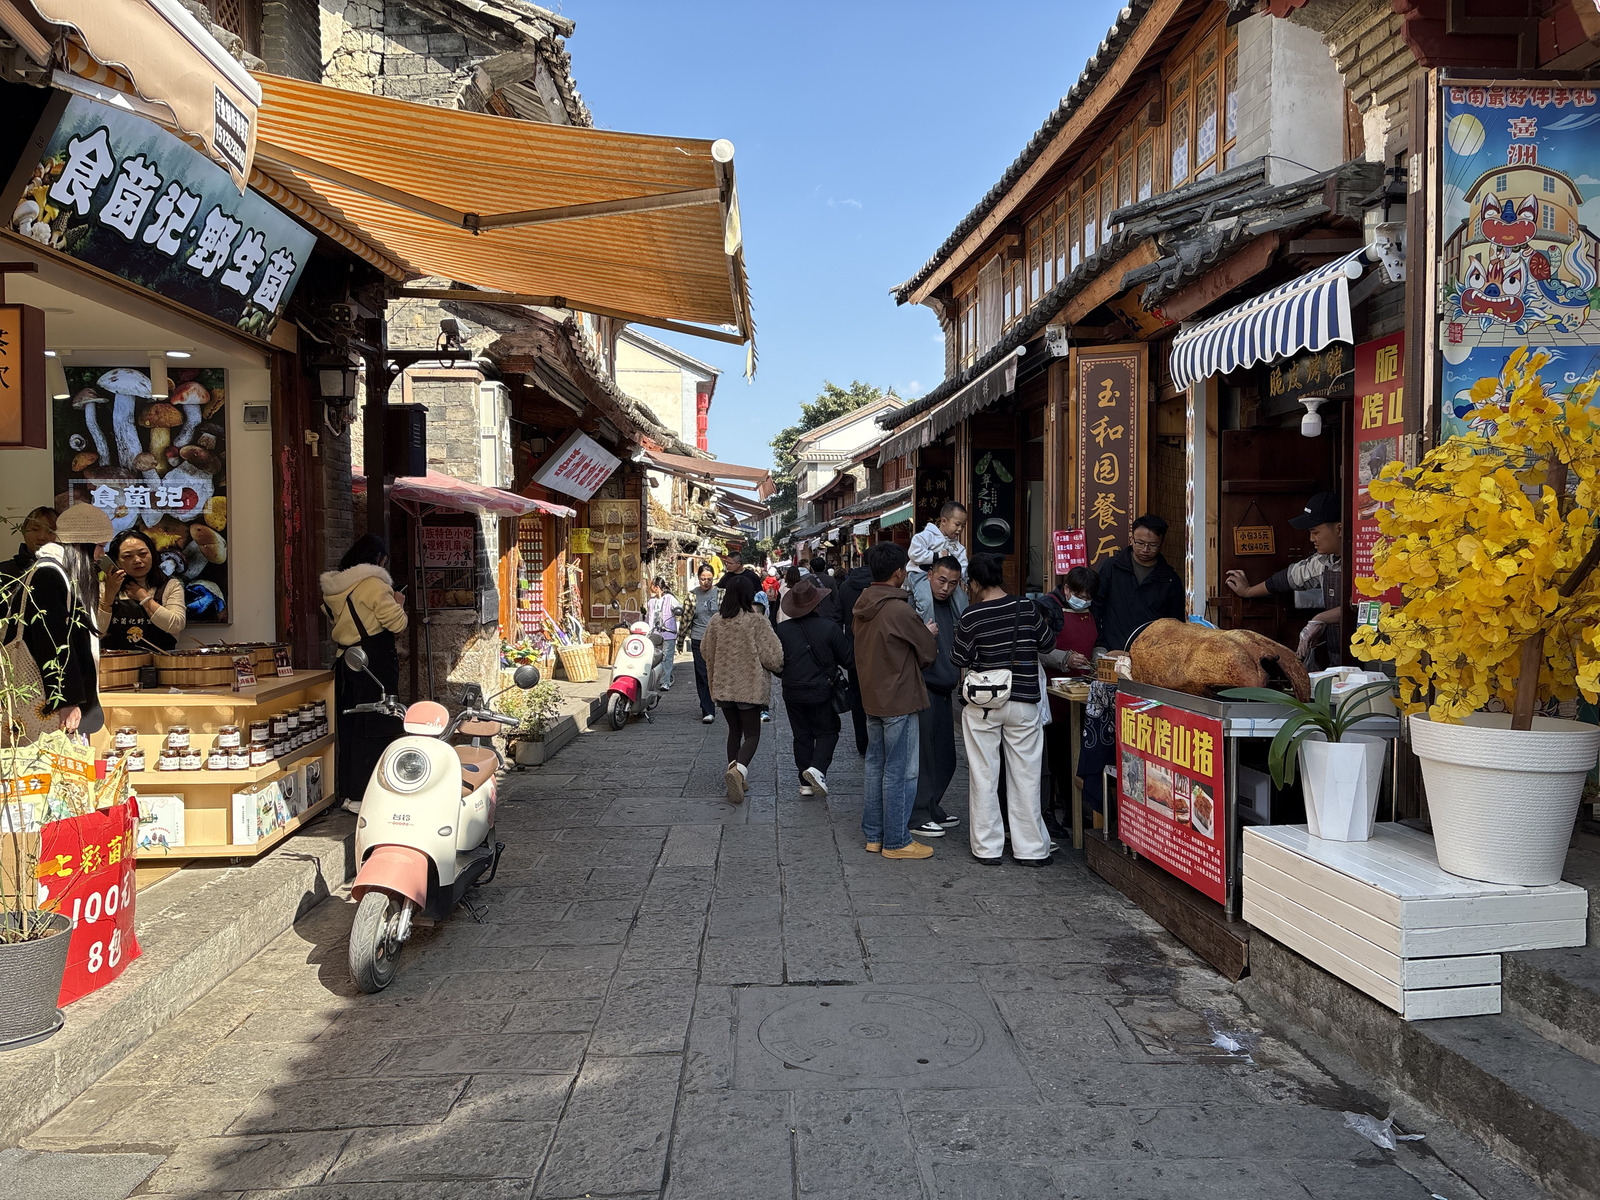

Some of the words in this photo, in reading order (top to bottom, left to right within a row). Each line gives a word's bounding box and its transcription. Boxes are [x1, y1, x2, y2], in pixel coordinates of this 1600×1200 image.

[1451, 87, 1597, 108] 云南最好伴手礼
[1507, 116, 1537, 167] 喜洲
[90, 484, 184, 509] 食菌记
[1121, 707, 1213, 778] 脆皮烤山猪
[72, 871, 131, 930] 100元
[87, 927, 122, 974] 8包
